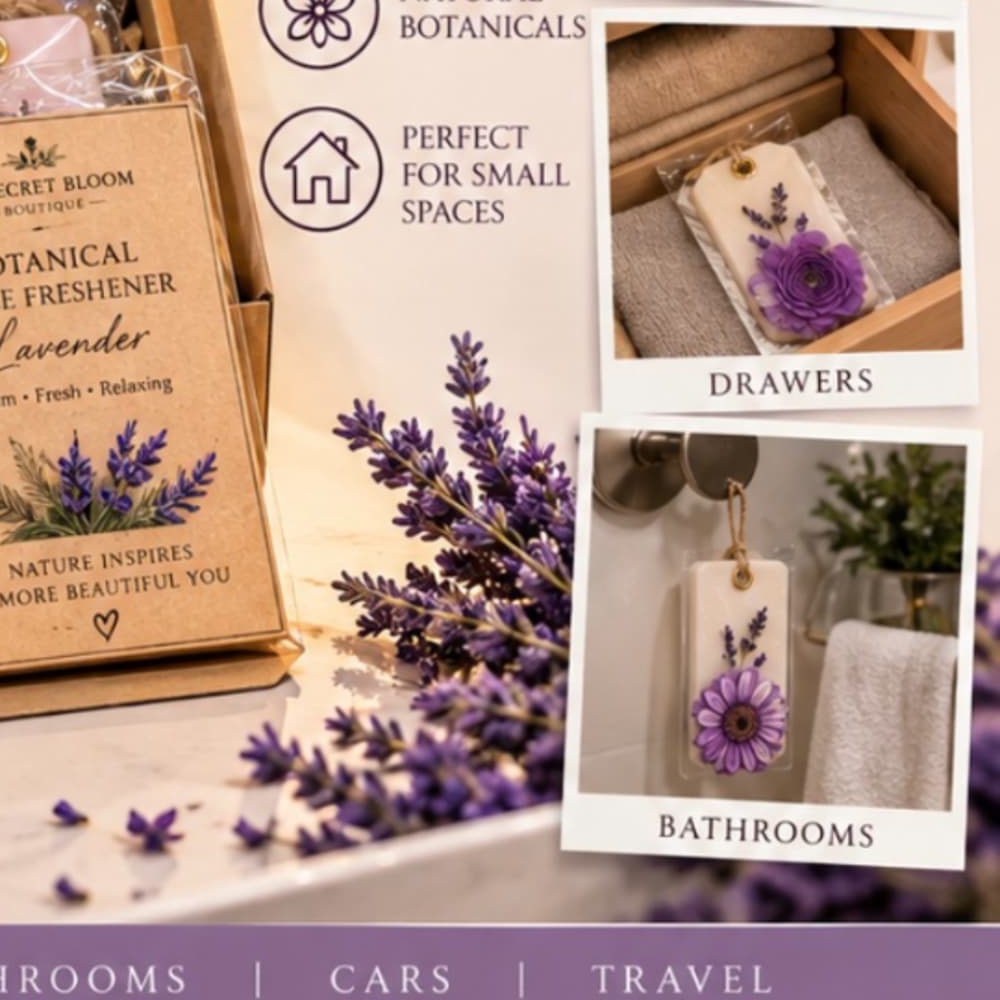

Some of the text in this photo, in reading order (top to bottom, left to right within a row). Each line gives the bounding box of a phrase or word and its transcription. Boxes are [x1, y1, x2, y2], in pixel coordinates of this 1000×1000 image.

[63, 170, 134, 192] BLOOM
[3, 198, 83, 216] BOUTIQUE
[24, 272, 176, 307] FRESHENER
[35, 384, 81, 403] Fresh
[100, 377, 173, 396] Relaxing
[9, 544, 194, 581] NATURE INSPIRES
[66, 572, 180, 600] BEAUTIFUL
[187, 566, 230, 586] YOU
